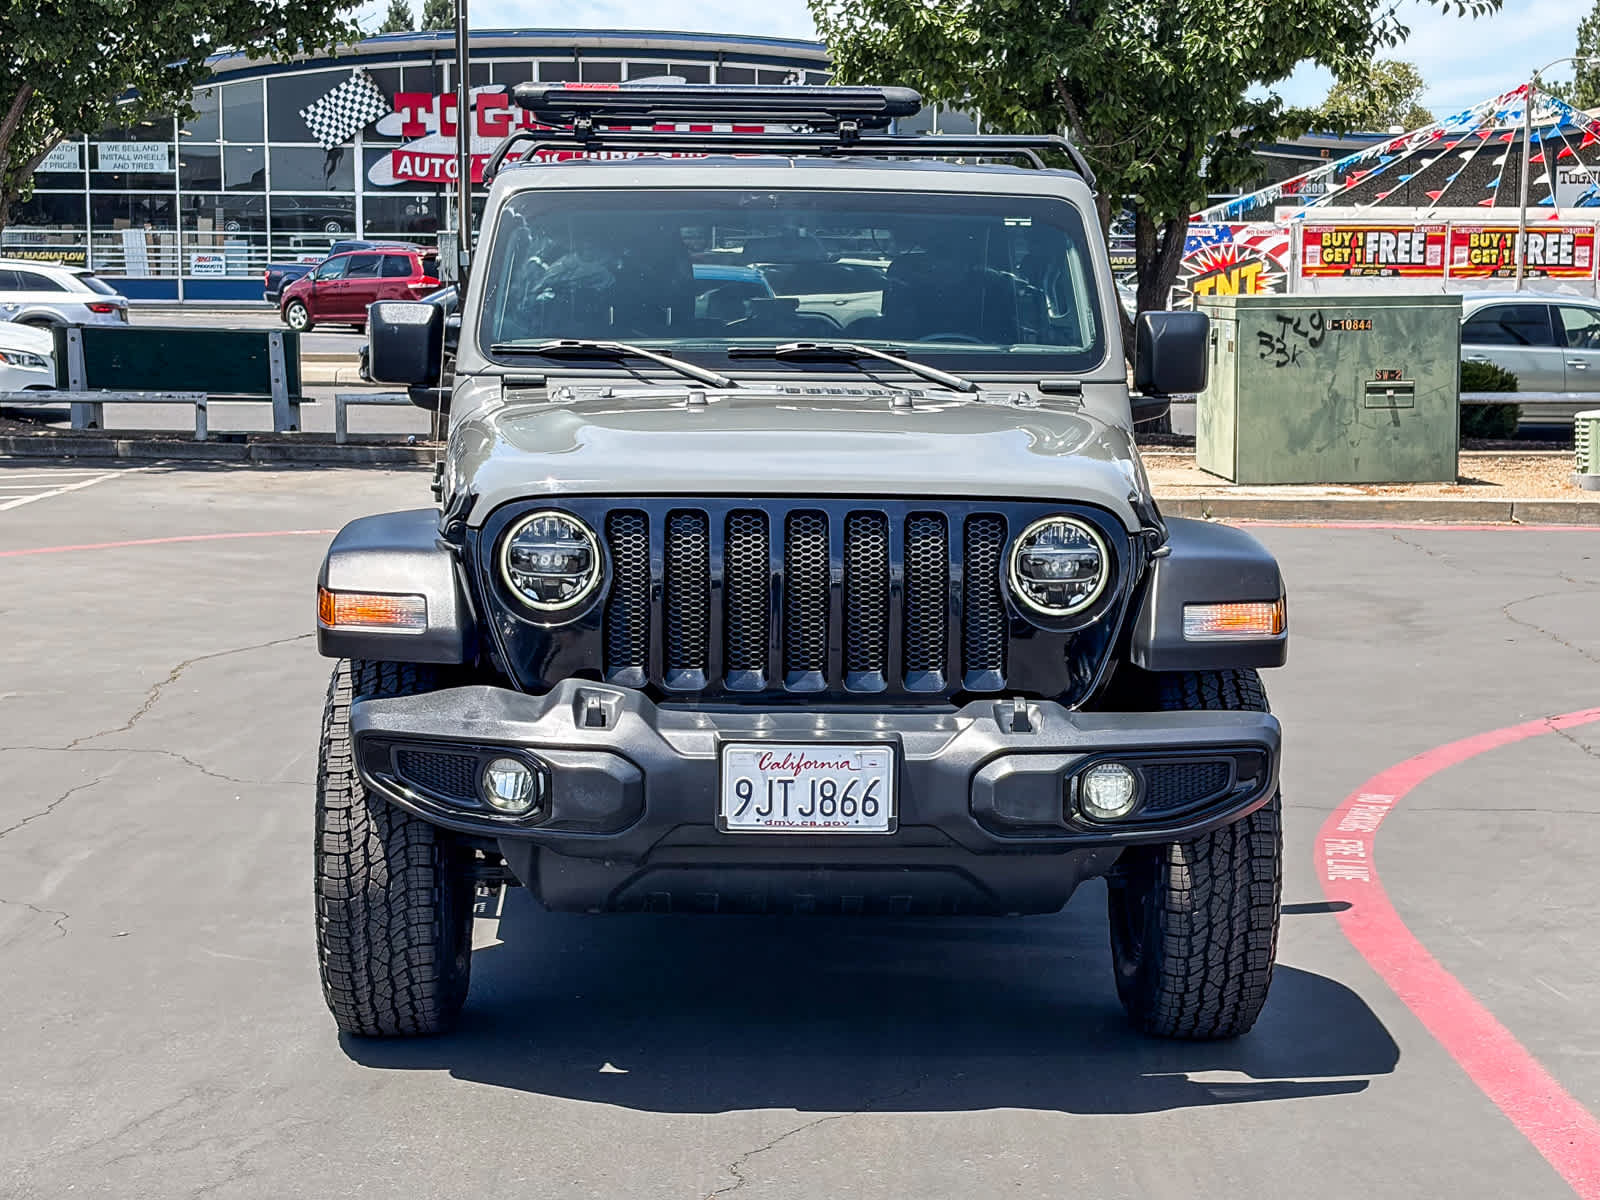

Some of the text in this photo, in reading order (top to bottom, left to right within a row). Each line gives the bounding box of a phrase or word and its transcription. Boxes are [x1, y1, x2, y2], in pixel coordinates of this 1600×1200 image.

[1322, 232, 1364, 246] BUY 1
[1470, 233, 1512, 247] BUY 1
[1366, 232, 1425, 263] FREE
[24, 251, 85, 261] MAGNAFLOW
[1322, 248, 1351, 262] GET
[1355, 248, 1362, 262] 1
[1470, 249, 1499, 263] GET
[1503, 249, 1510, 263] 1
[1193, 261, 1264, 296] TNT
[1326, 319, 1372, 330] U-10844
[1376, 370, 1402, 380] SW-2
[758, 751, 862, 776] California
[764, 819, 850, 827] dmv.ca.gov
[1323, 838, 1366, 857] FIRE
[1326, 858, 1370, 882] LANE
